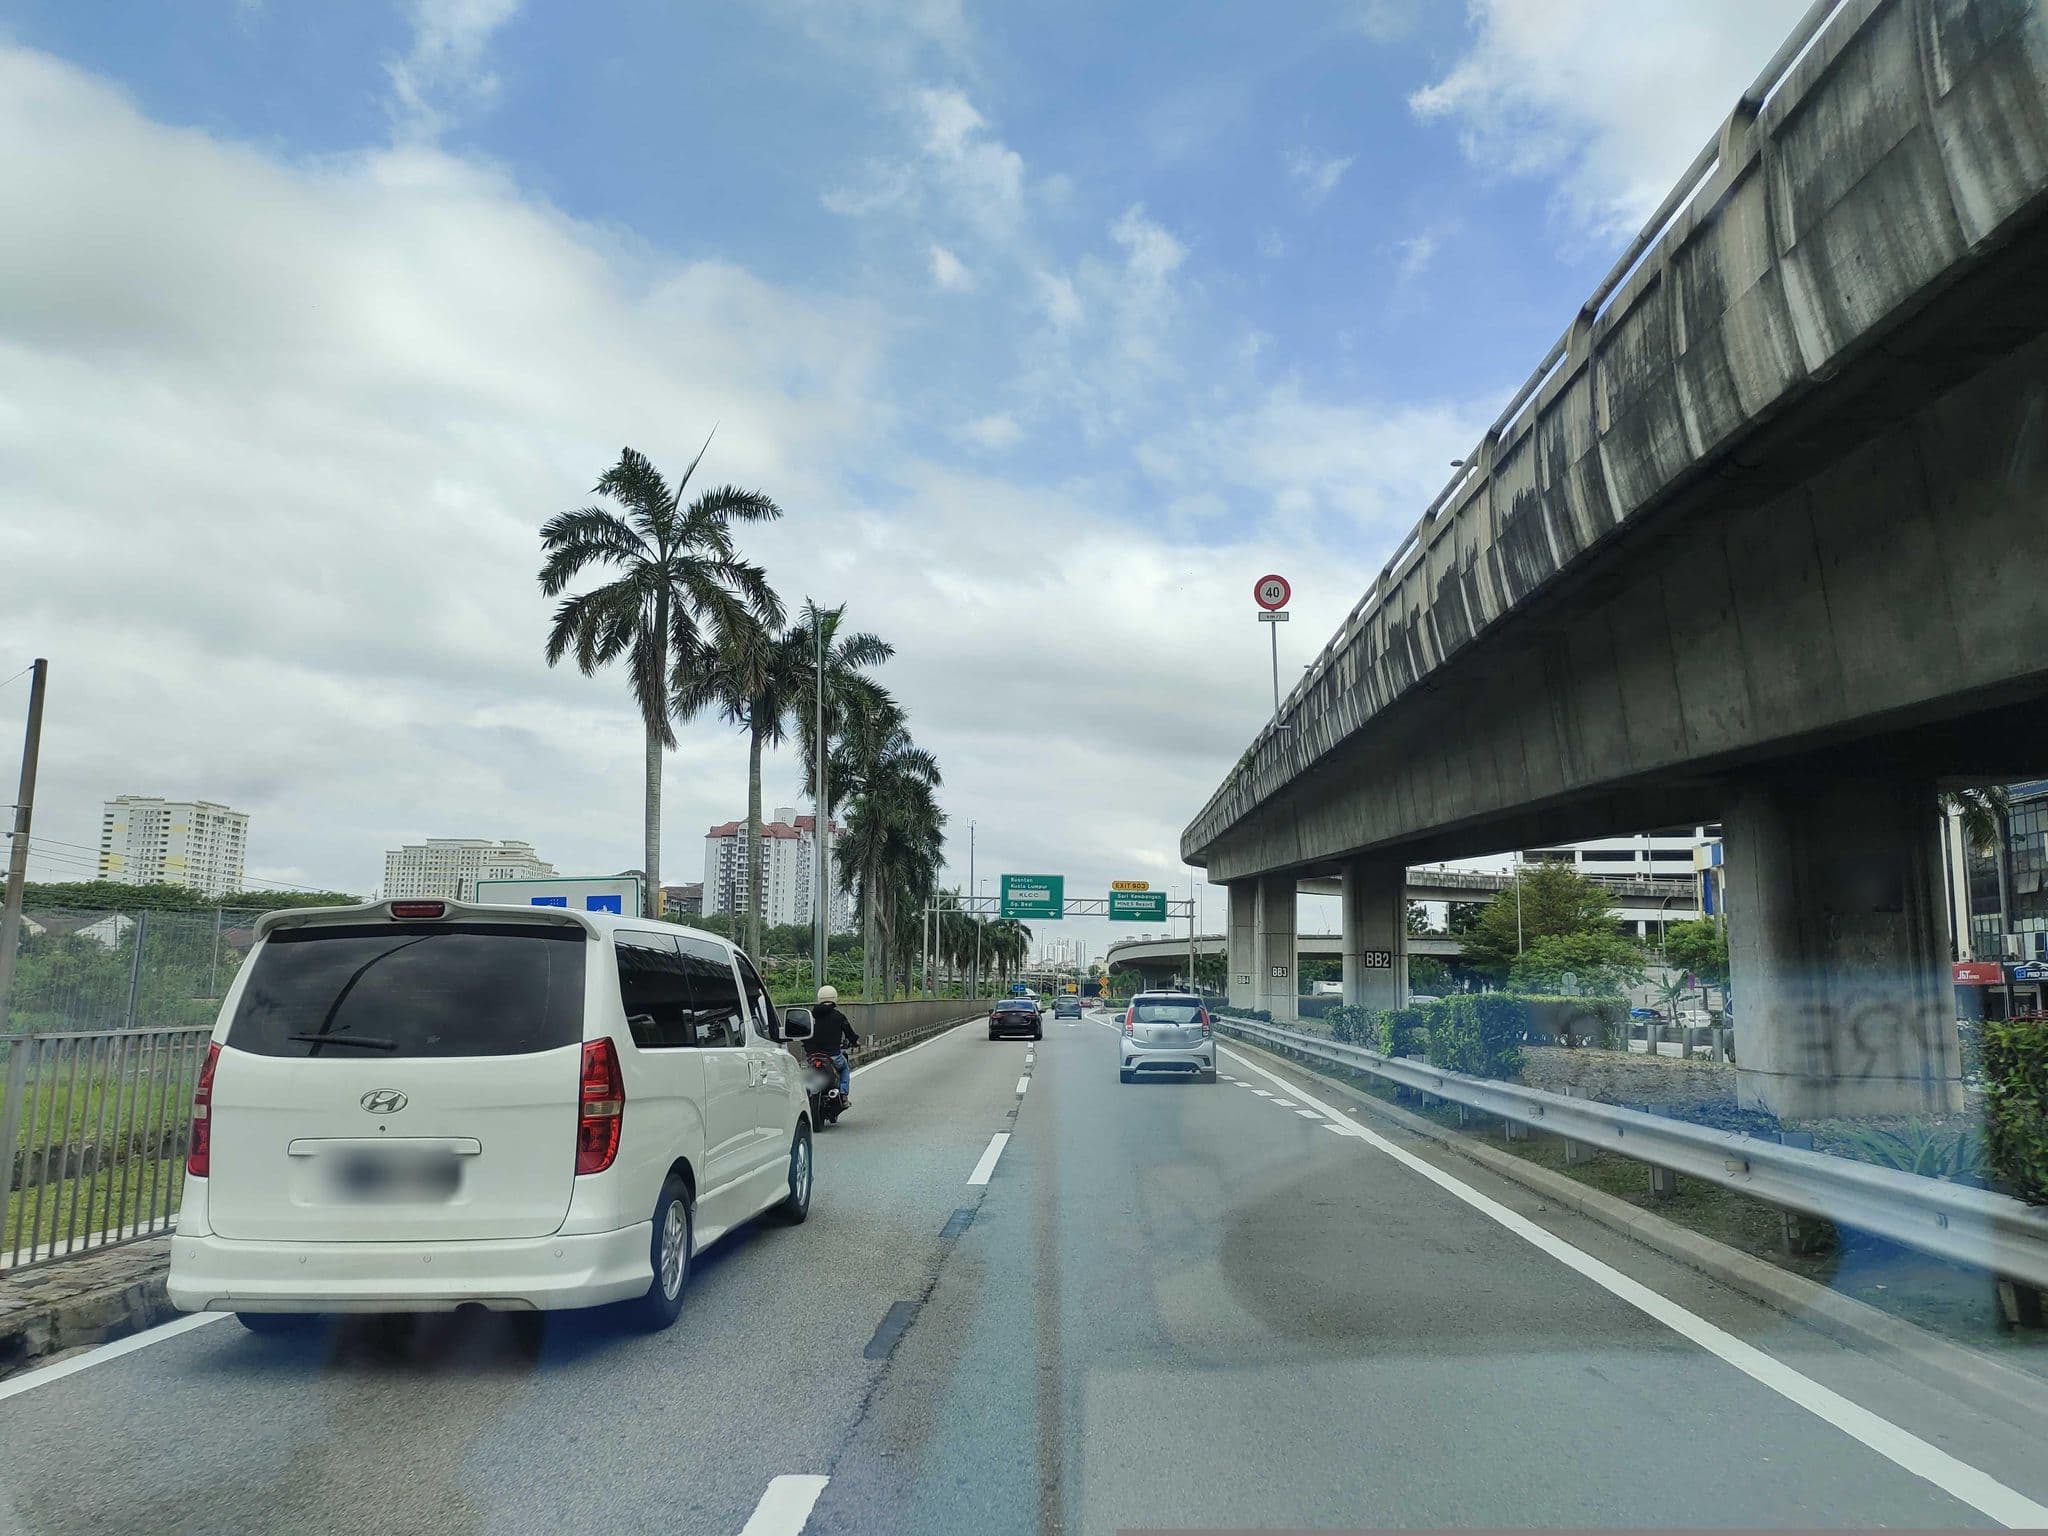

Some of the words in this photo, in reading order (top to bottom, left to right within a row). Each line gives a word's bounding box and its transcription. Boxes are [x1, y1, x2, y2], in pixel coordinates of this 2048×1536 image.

[1265, 586, 1280, 599] 40
[1366, 952, 1389, 966] BB2
[1272, 967, 1287, 977] BB3
[1957, 970, 1971, 980] J&T
